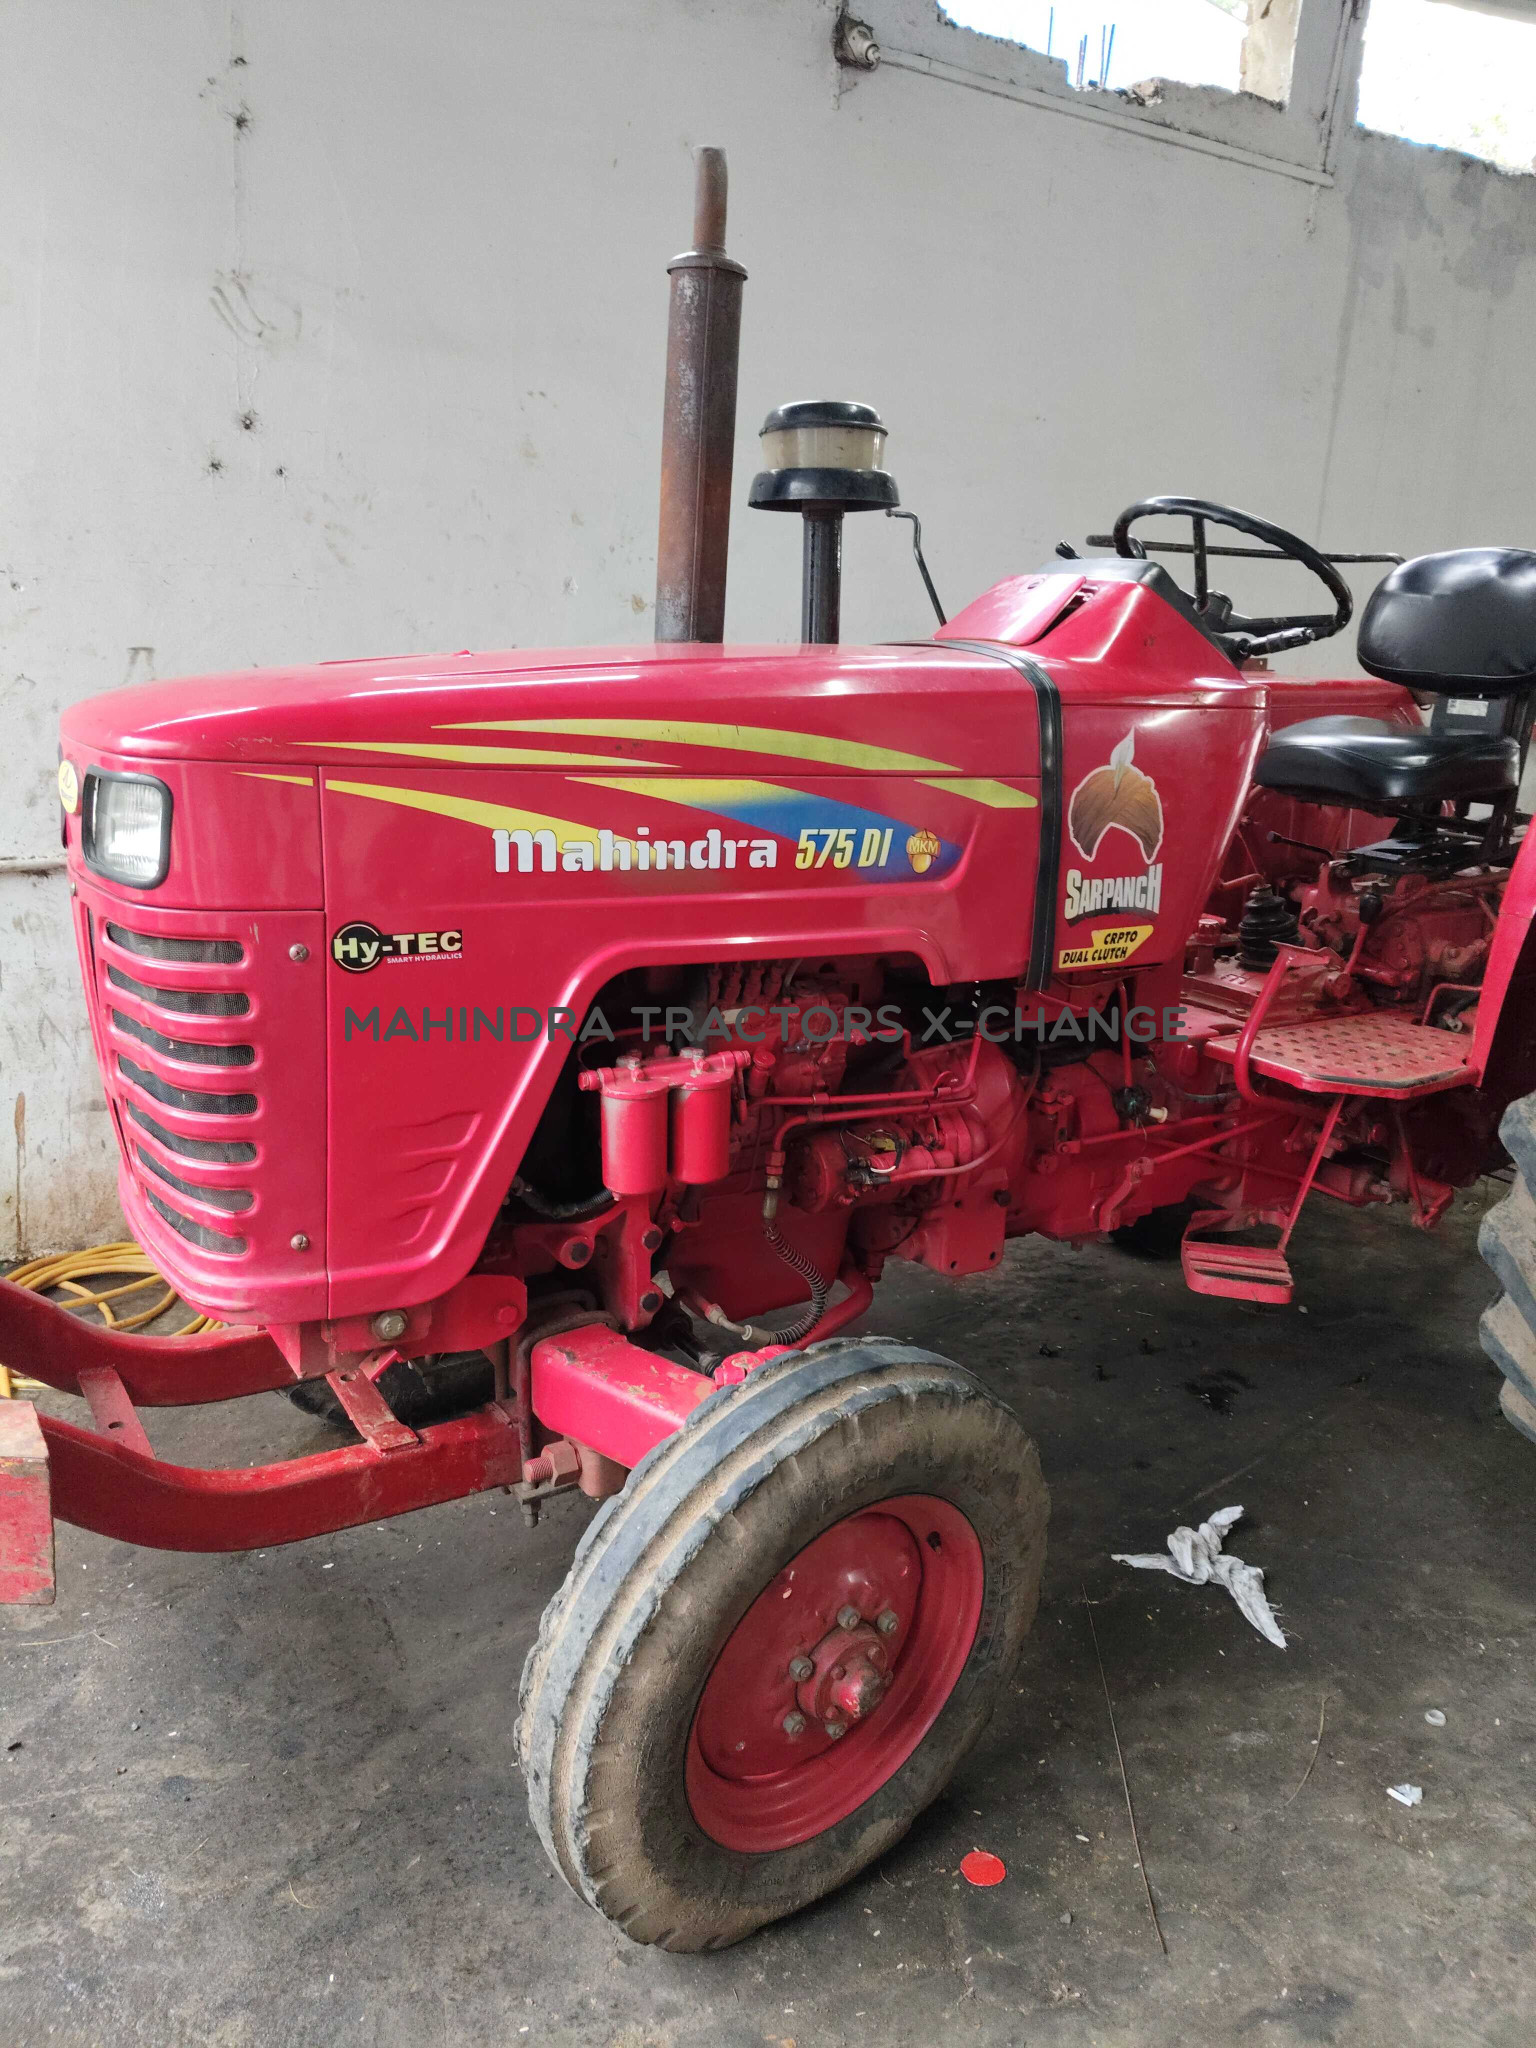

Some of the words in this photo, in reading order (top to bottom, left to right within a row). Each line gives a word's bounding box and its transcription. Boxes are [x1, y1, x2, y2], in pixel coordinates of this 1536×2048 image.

[795, 828, 857, 870] 575
[857, 828, 894, 868] DI
[908, 837, 939, 856] MKM
[333, 931, 462, 963] Hy-TEC
[1103, 930, 1139, 946] CRPTO
[387, 956, 413, 964] SMART
[414, 952, 462, 962] HYDRAULICS
[1062, 952, 1089, 965] DUAL
[1091, 946, 1128, 962] CLUTCH
